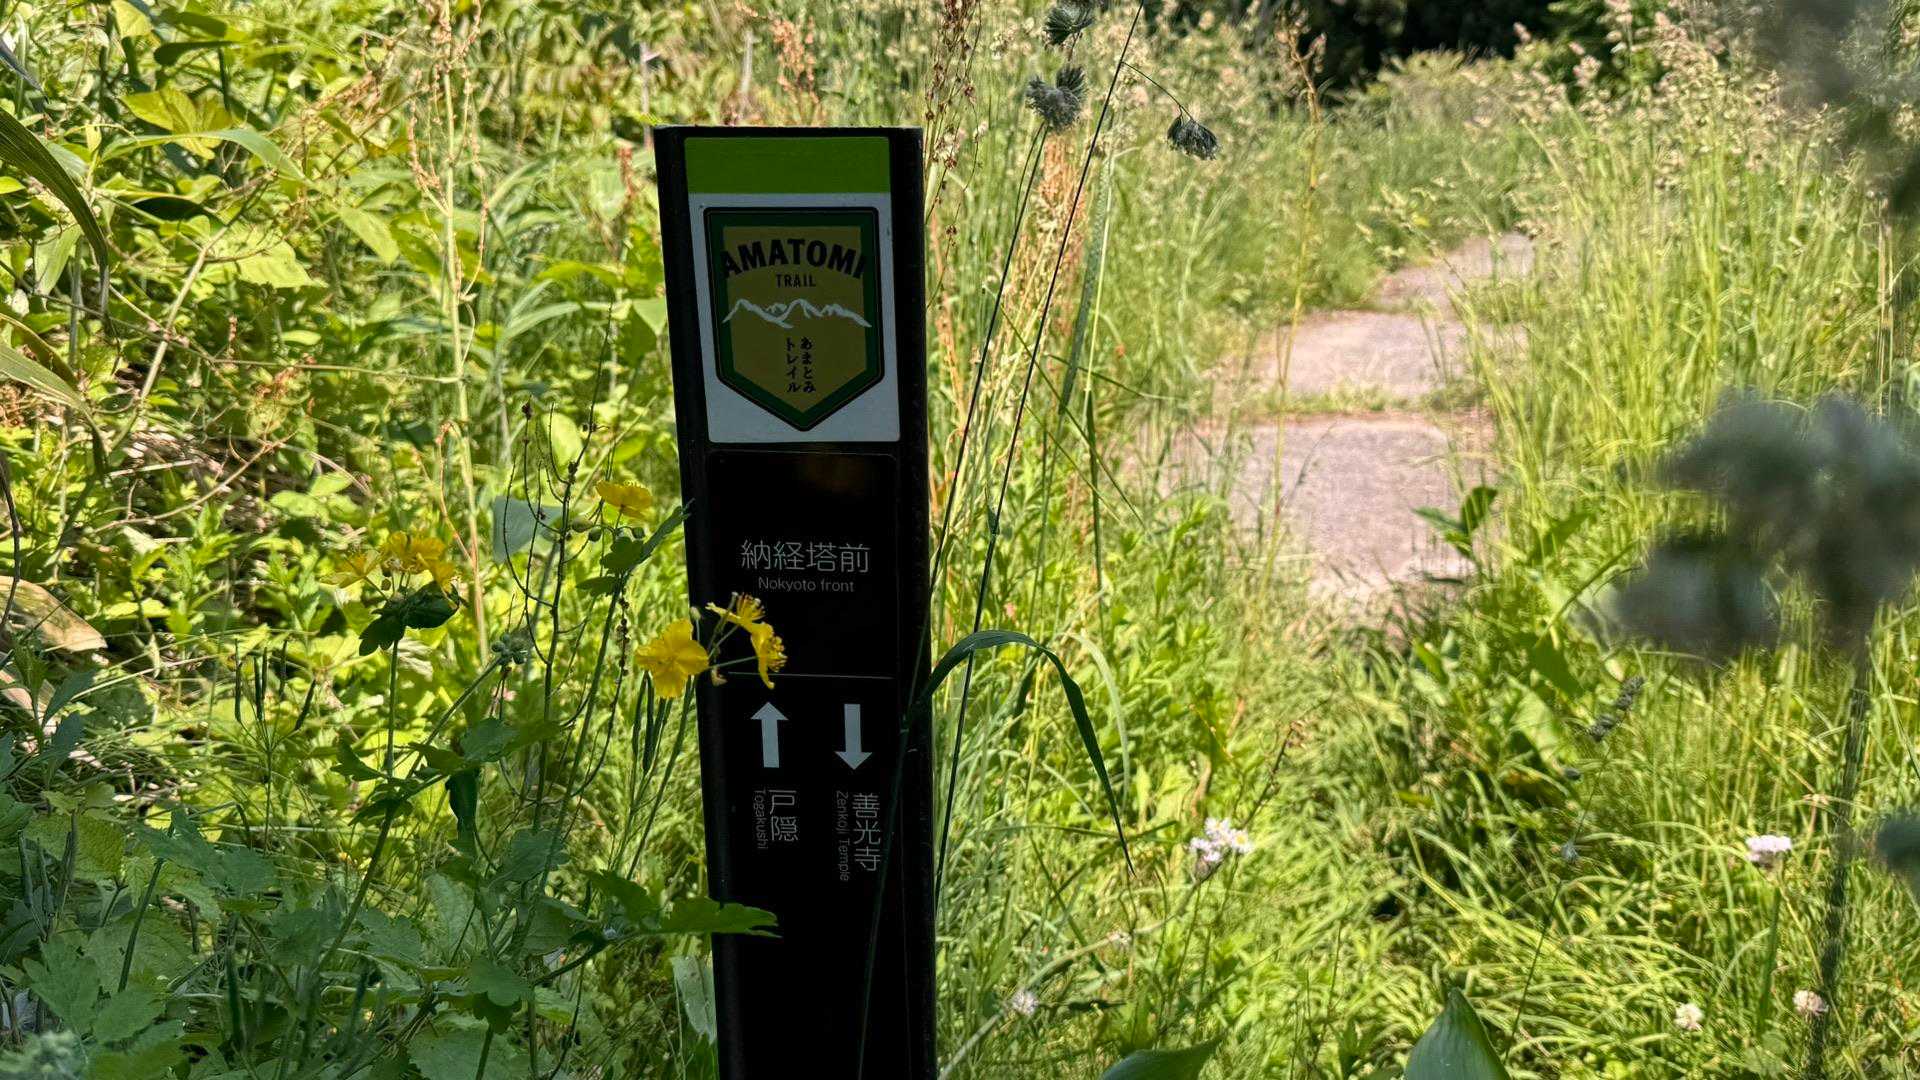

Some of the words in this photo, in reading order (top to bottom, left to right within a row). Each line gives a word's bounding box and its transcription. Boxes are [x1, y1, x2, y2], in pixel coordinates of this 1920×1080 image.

[719, 237, 867, 280] AMATOMI
[775, 273, 817, 289] TRAIL
[786, 337, 800, 393] トレイル
[800, 336, 816, 394] あまとみ
[741, 539, 871, 573] 納経塔前
[758, 576, 816, 592] Nokyoto
[820, 578, 855, 592] front
[753, 787, 768, 850] Togakushi
[768, 789, 799, 842] 戸隠
[836, 790, 849, 834] Zenkoji
[852, 792, 881, 872] 善光寺
[839, 838, 850, 882] Temple
